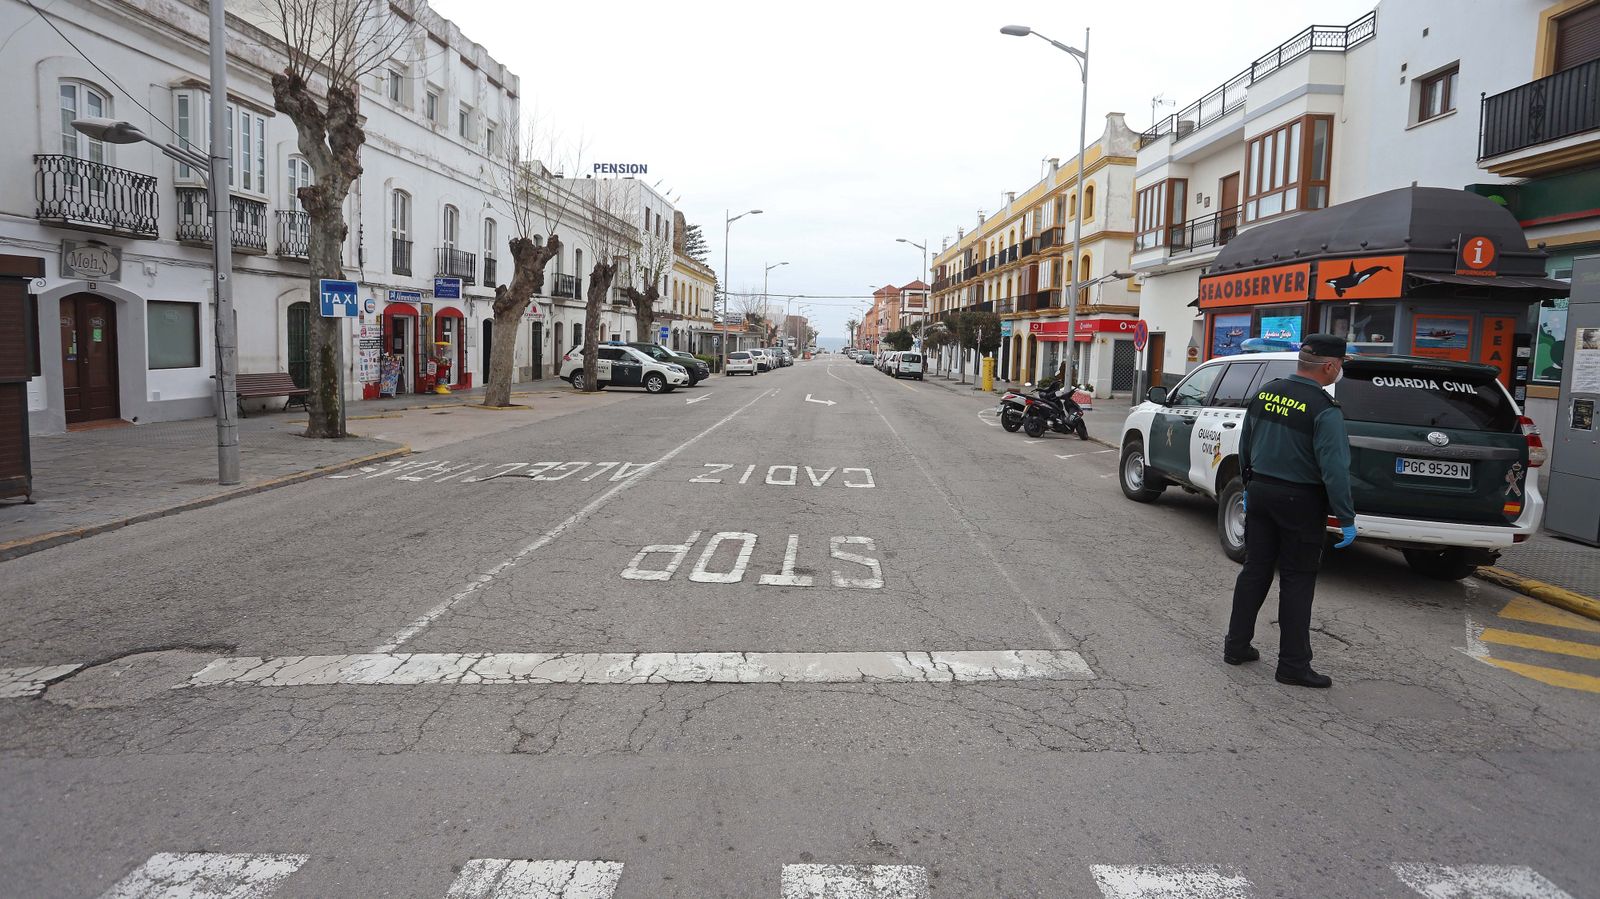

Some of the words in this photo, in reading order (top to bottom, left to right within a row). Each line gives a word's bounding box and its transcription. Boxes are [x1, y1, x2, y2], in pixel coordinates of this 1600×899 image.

[593, 163, 648, 174] PENSION
[1201, 271, 1305, 301] SEAOBSERVER
[322, 292, 357, 305] TAXI
[1372, 376, 1440, 390] GUARDIA
[1442, 381, 1478, 394] CIVIL
[1258, 391, 1307, 413] GUARDIA
[1264, 403, 1289, 417] CIVIL
[1198, 428, 1221, 442] GUARDIA
[1202, 442, 1213, 455] CIVIL
[689, 463, 876, 488] CADIZ
[1403, 460, 1426, 474] PGC
[1428, 462, 1458, 476] 9529
[1460, 466, 1469, 477] N
[619, 530, 885, 590] STOP
